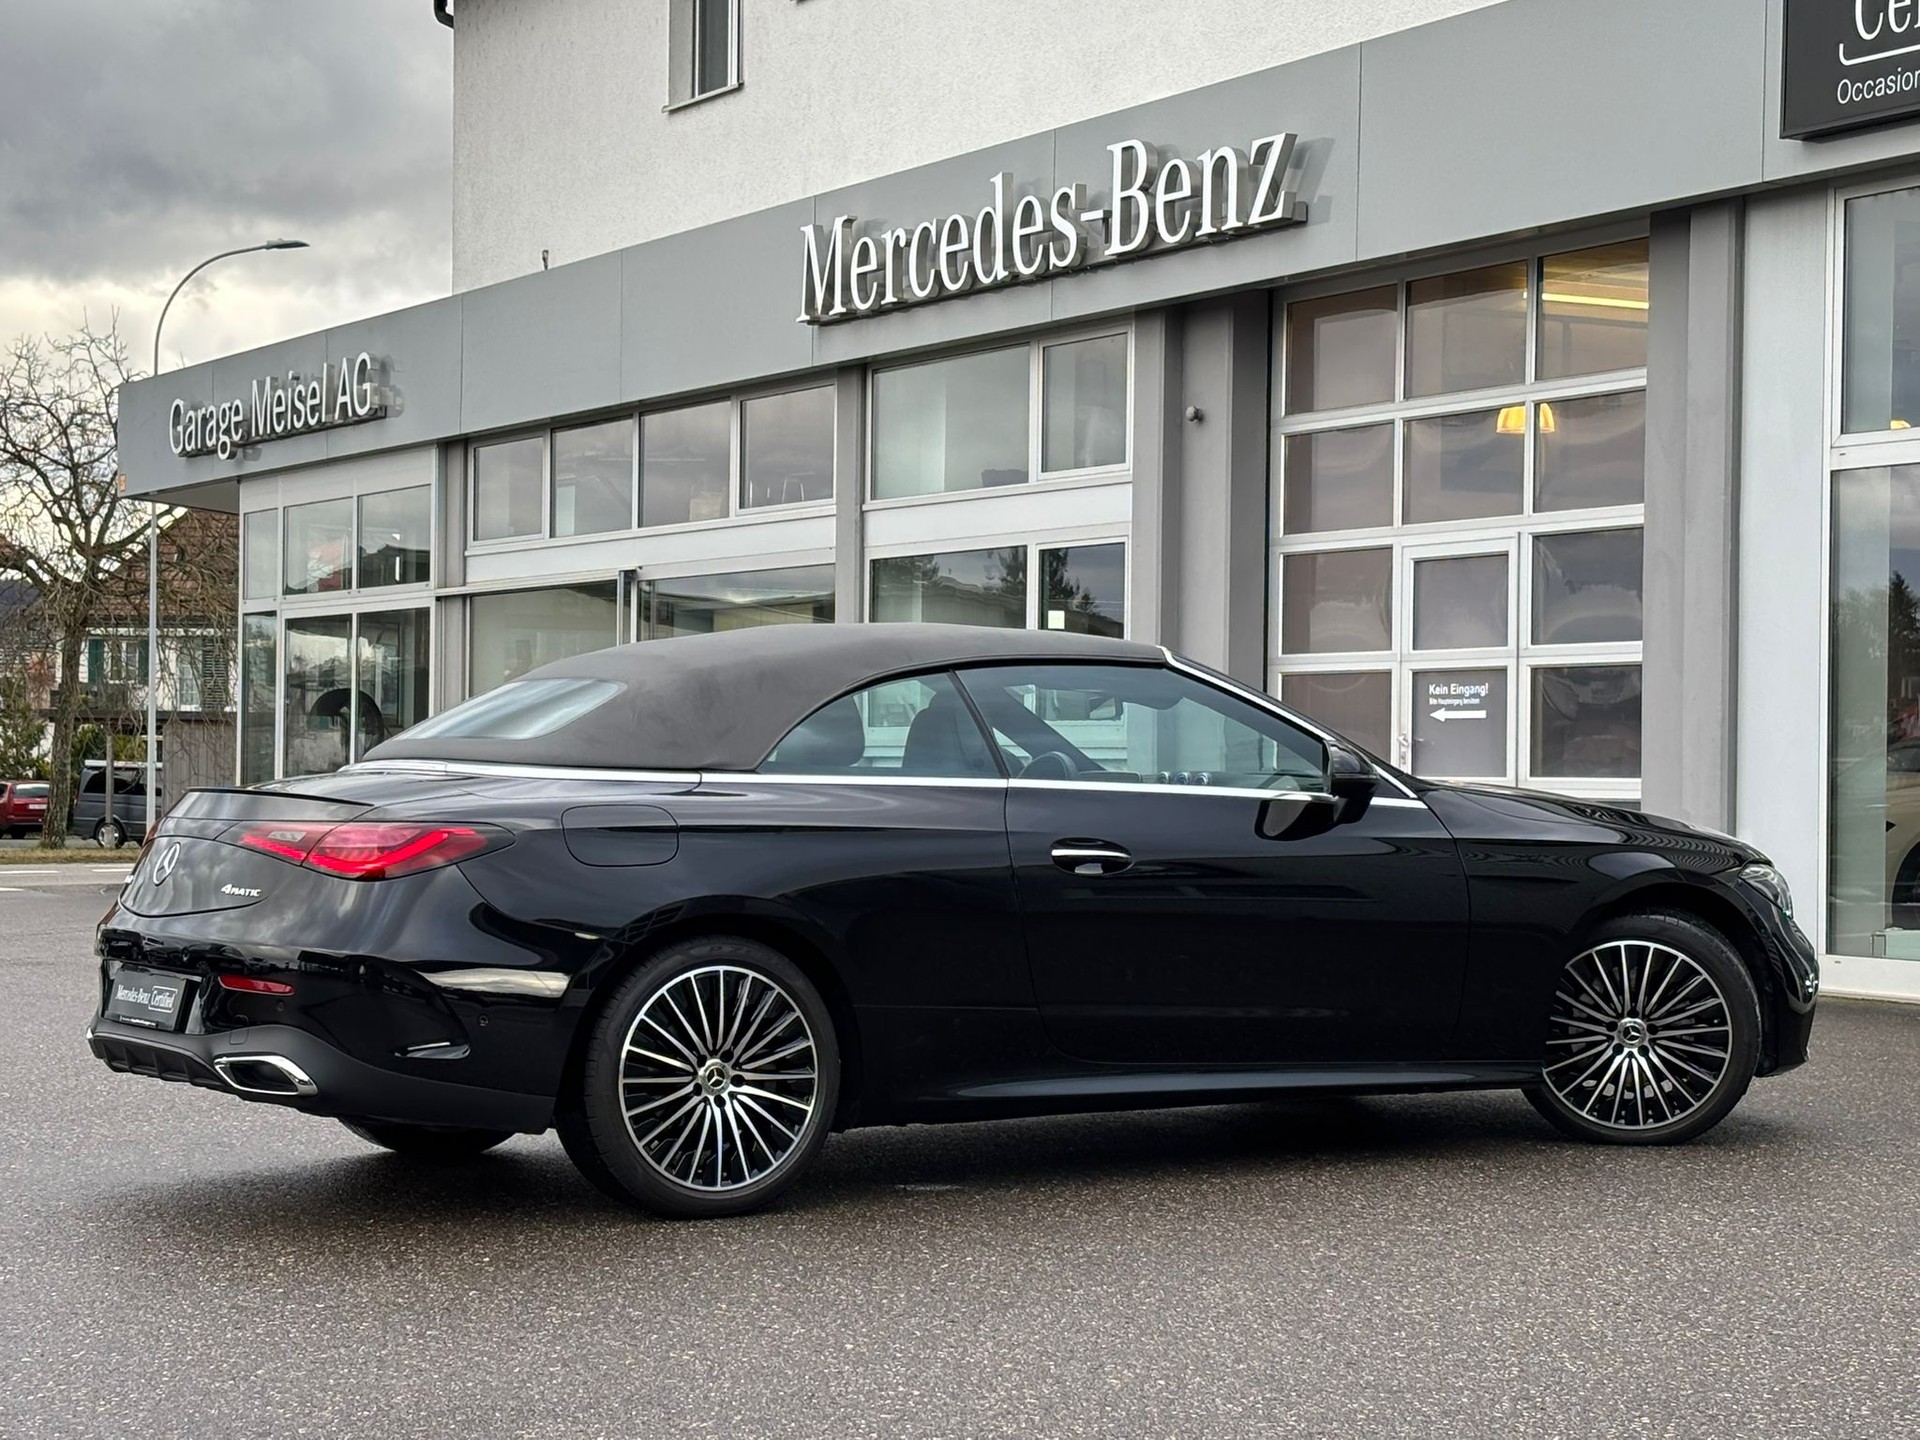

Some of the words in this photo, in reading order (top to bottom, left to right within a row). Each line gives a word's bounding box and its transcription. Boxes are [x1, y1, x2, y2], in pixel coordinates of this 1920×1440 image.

[1855, 0, 1920, 40] Ce
[797, 132, 1293, 323] Mercedes-Benz
[169, 398, 243, 460] Garage
[251, 362, 326, 437] Meisel
[334, 351, 372, 420] AG
[1429, 683, 1448, 695] Kein
[1450, 682, 1489, 697] Eingang!
[220, 883, 262, 897] 4MATIC
[116, 984, 151, 1005] Mercedes-Benz
[151, 989, 175, 1008] Certified
